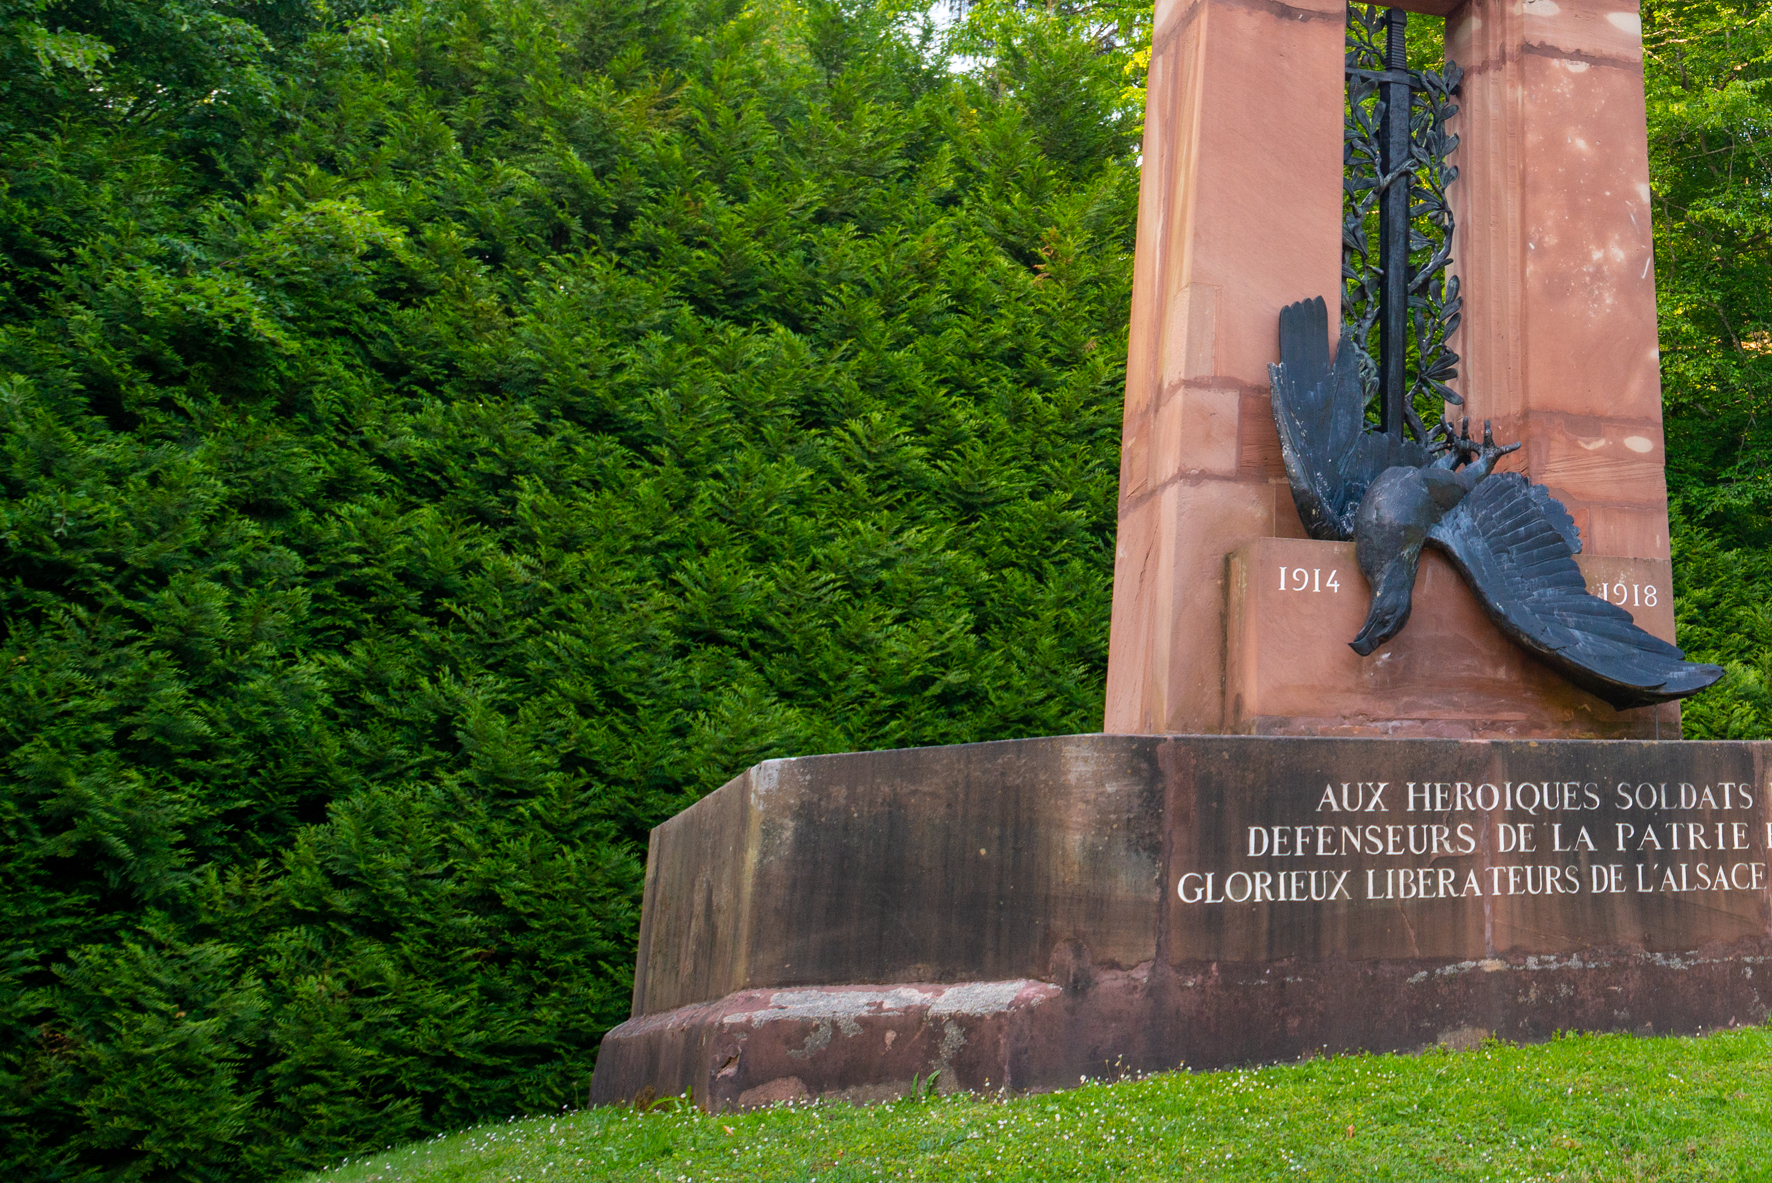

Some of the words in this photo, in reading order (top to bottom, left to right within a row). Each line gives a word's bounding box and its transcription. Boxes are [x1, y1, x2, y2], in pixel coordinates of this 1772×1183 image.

[1278, 566, 1340, 593] 1914
[1602, 582, 1658, 607] 1918
[1315, 781, 1390, 812] AUX
[1406, 781, 1601, 815] HEROIQUES
[1615, 782, 1753, 810] SOLDATS
[1246, 823, 1476, 857] DEFENSEURS
[1497, 823, 1536, 853] DE
[1552, 823, 1598, 852] LA
[1615, 822, 1750, 851] PATRIE
[1177, 870, 1352, 904] GLORIEUX
[1365, 864, 1580, 900] LIBERATEURS
[1590, 864, 1627, 894] DE
